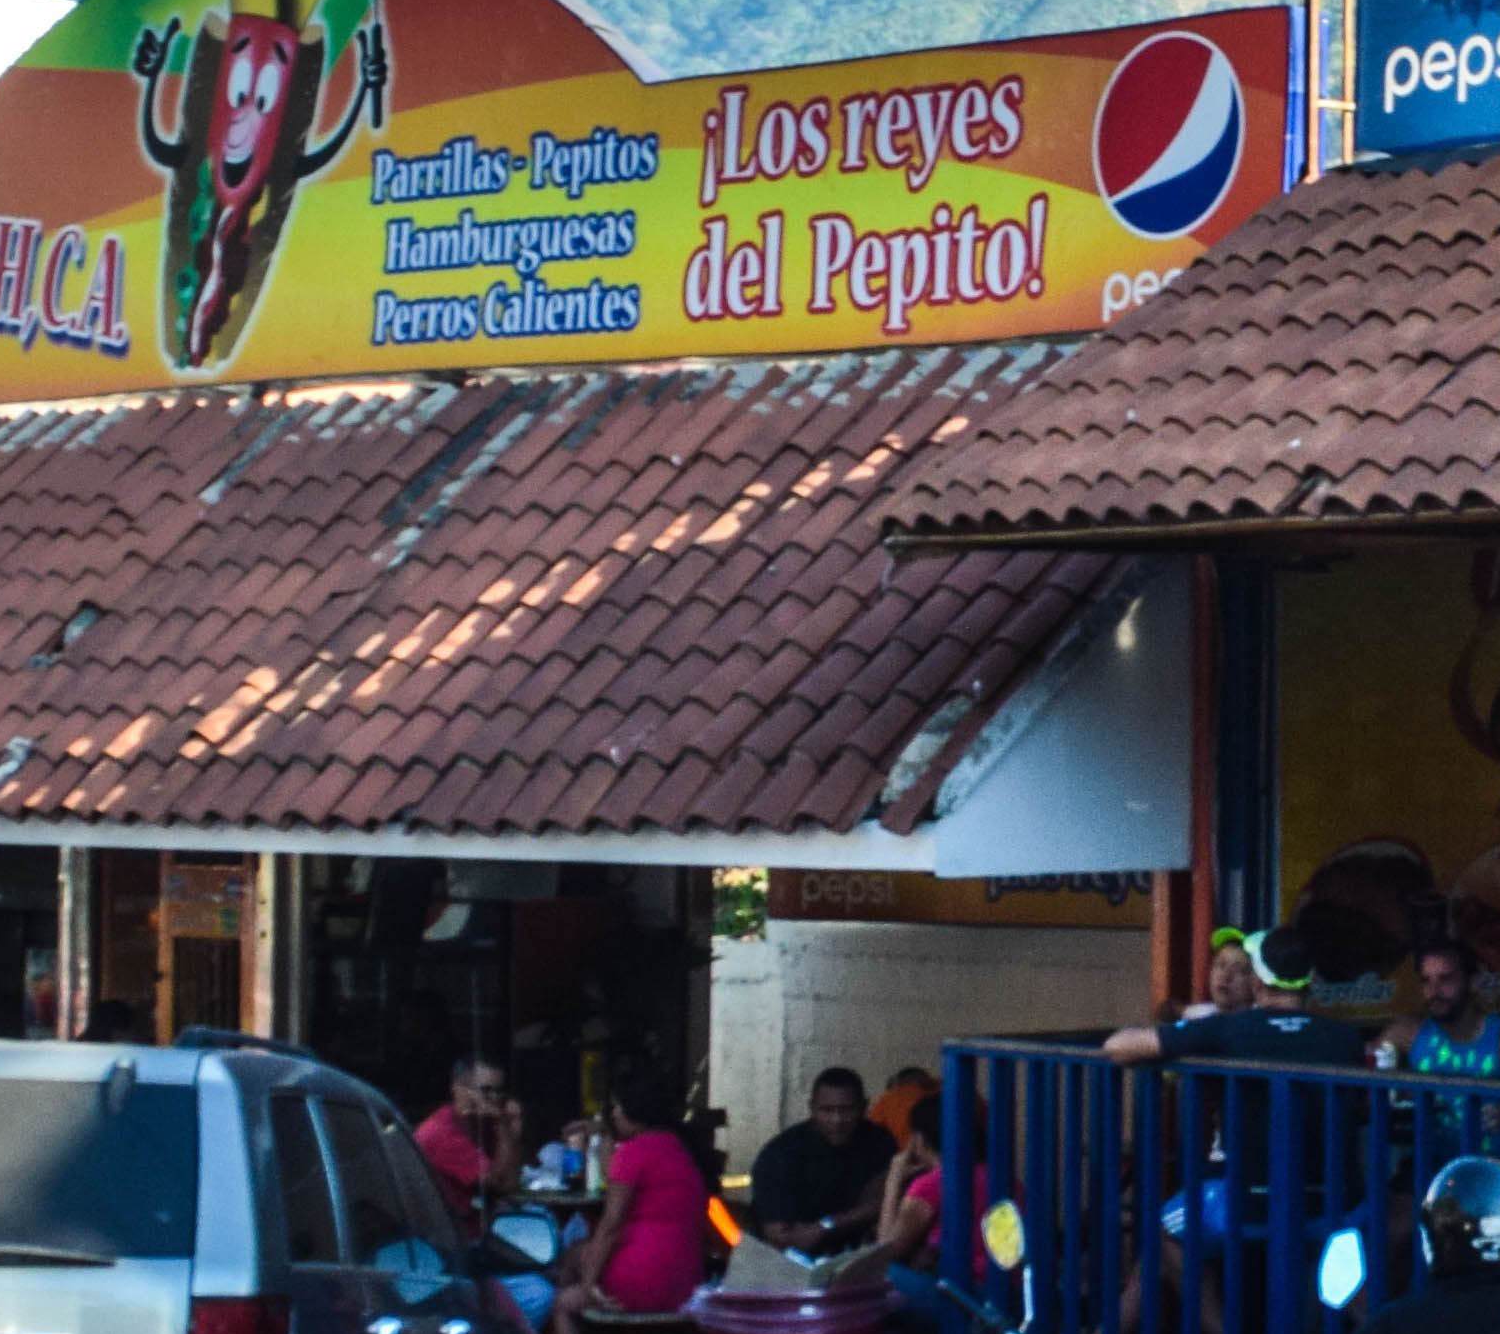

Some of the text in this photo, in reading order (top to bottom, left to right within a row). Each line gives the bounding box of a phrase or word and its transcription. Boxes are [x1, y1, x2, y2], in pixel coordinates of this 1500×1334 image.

[372, 137, 508, 205] Parrillas
[527, 129, 658, 200] Pepitos
[698, 74, 1025, 205] ¡Los reyes
[384, 210, 637, 279] Hamburguesas
[683, 211, 784, 322] del
[809, 196, 1052, 336] Pepito!
[372, 279, 640, 346] Perros Calientes
